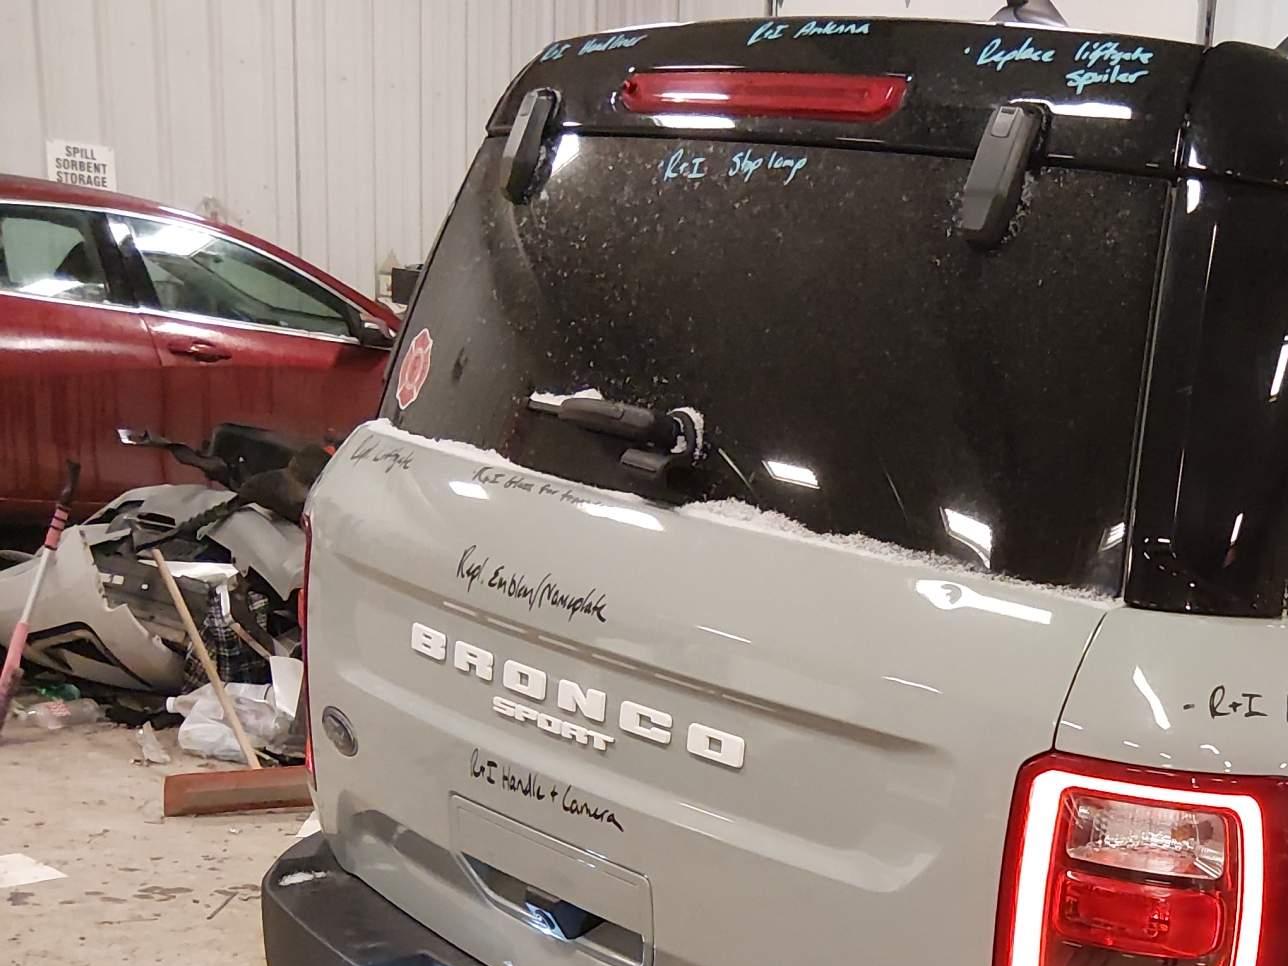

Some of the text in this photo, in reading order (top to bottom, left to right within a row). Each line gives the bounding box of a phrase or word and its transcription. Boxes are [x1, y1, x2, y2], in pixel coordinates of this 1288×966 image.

[976, 36, 1154, 71] Replace liftgate
[1064, 64, 1150, 95] spoiler
[55, 157, 108, 175] SORBENT
[65, 145, 97, 161] SPILL
[56, 170, 108, 188] STORAGE
[411, 621, 746, 769] BRONCO
[1208, 684, 1269, 720] R+I
[492, 695, 616, 751] SPORT
[562, 783, 625, 832] Camera
